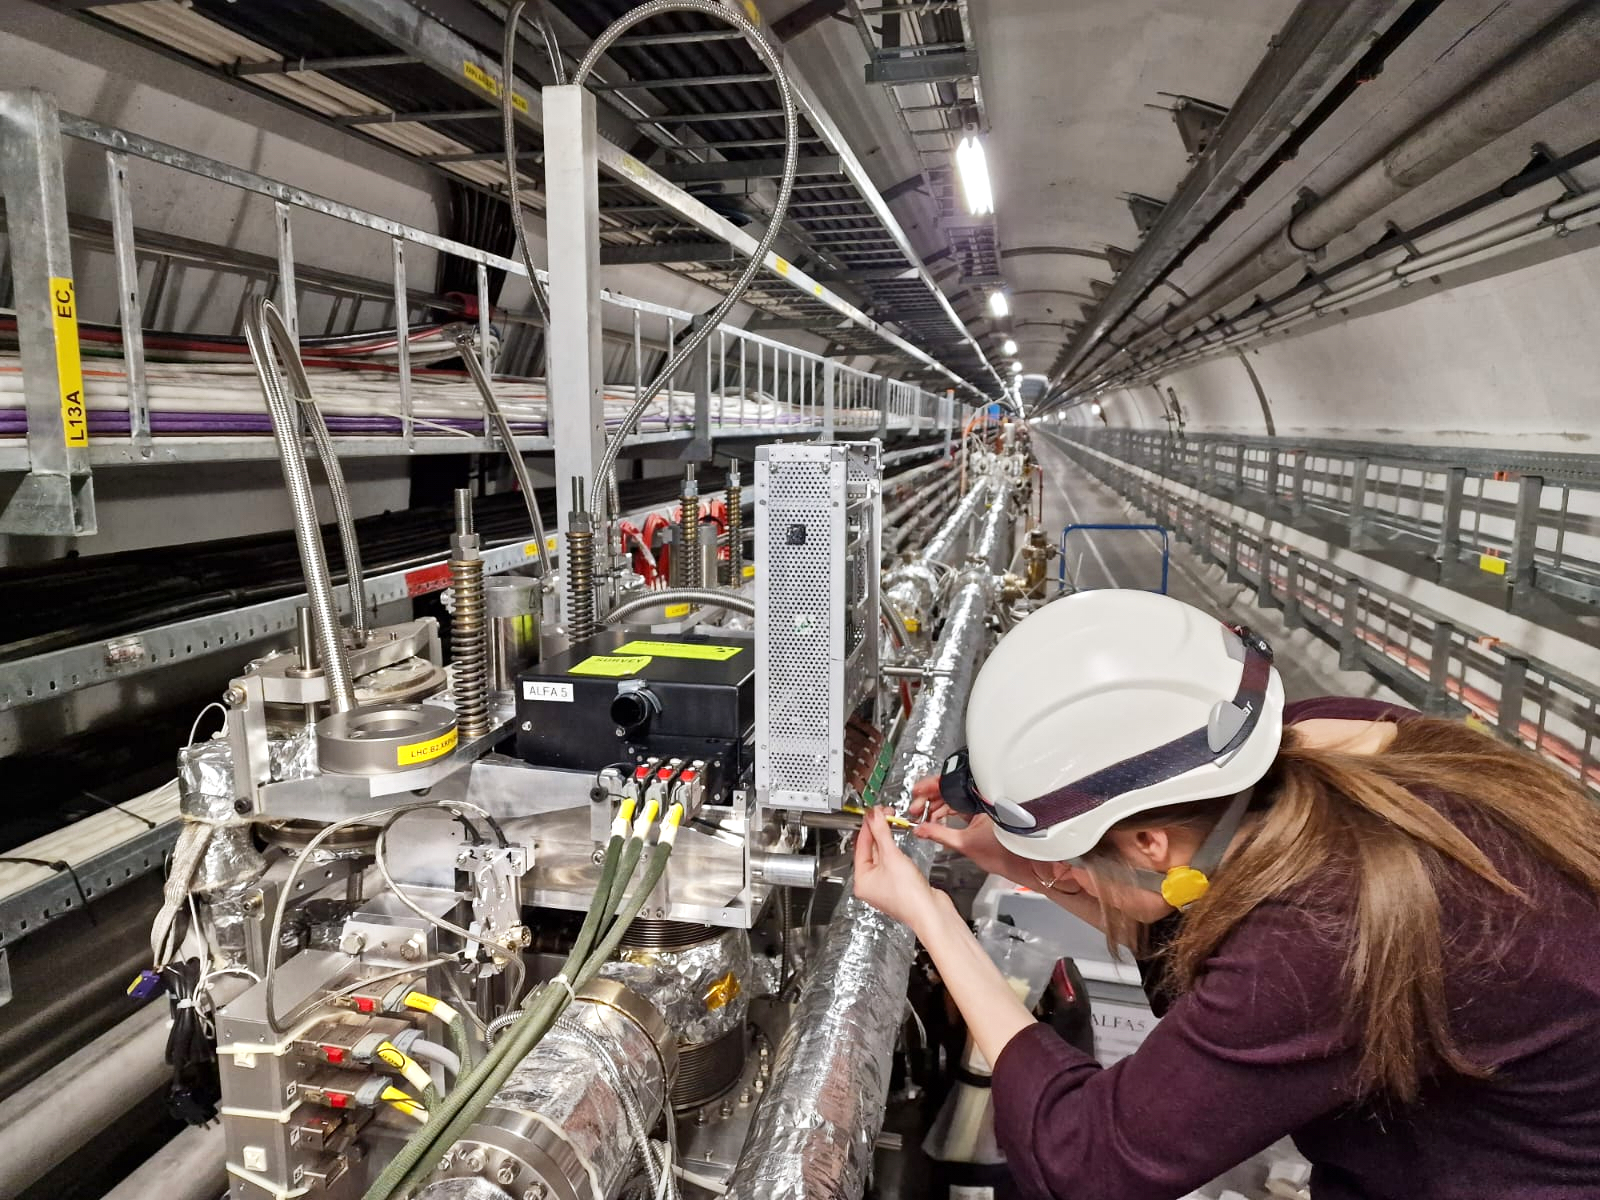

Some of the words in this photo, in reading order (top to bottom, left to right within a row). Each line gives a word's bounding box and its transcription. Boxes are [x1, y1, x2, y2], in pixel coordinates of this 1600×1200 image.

[66, 390, 85, 441] L13A
[529, 686, 558, 697] ALFA
[561, 687, 568, 698] 5
